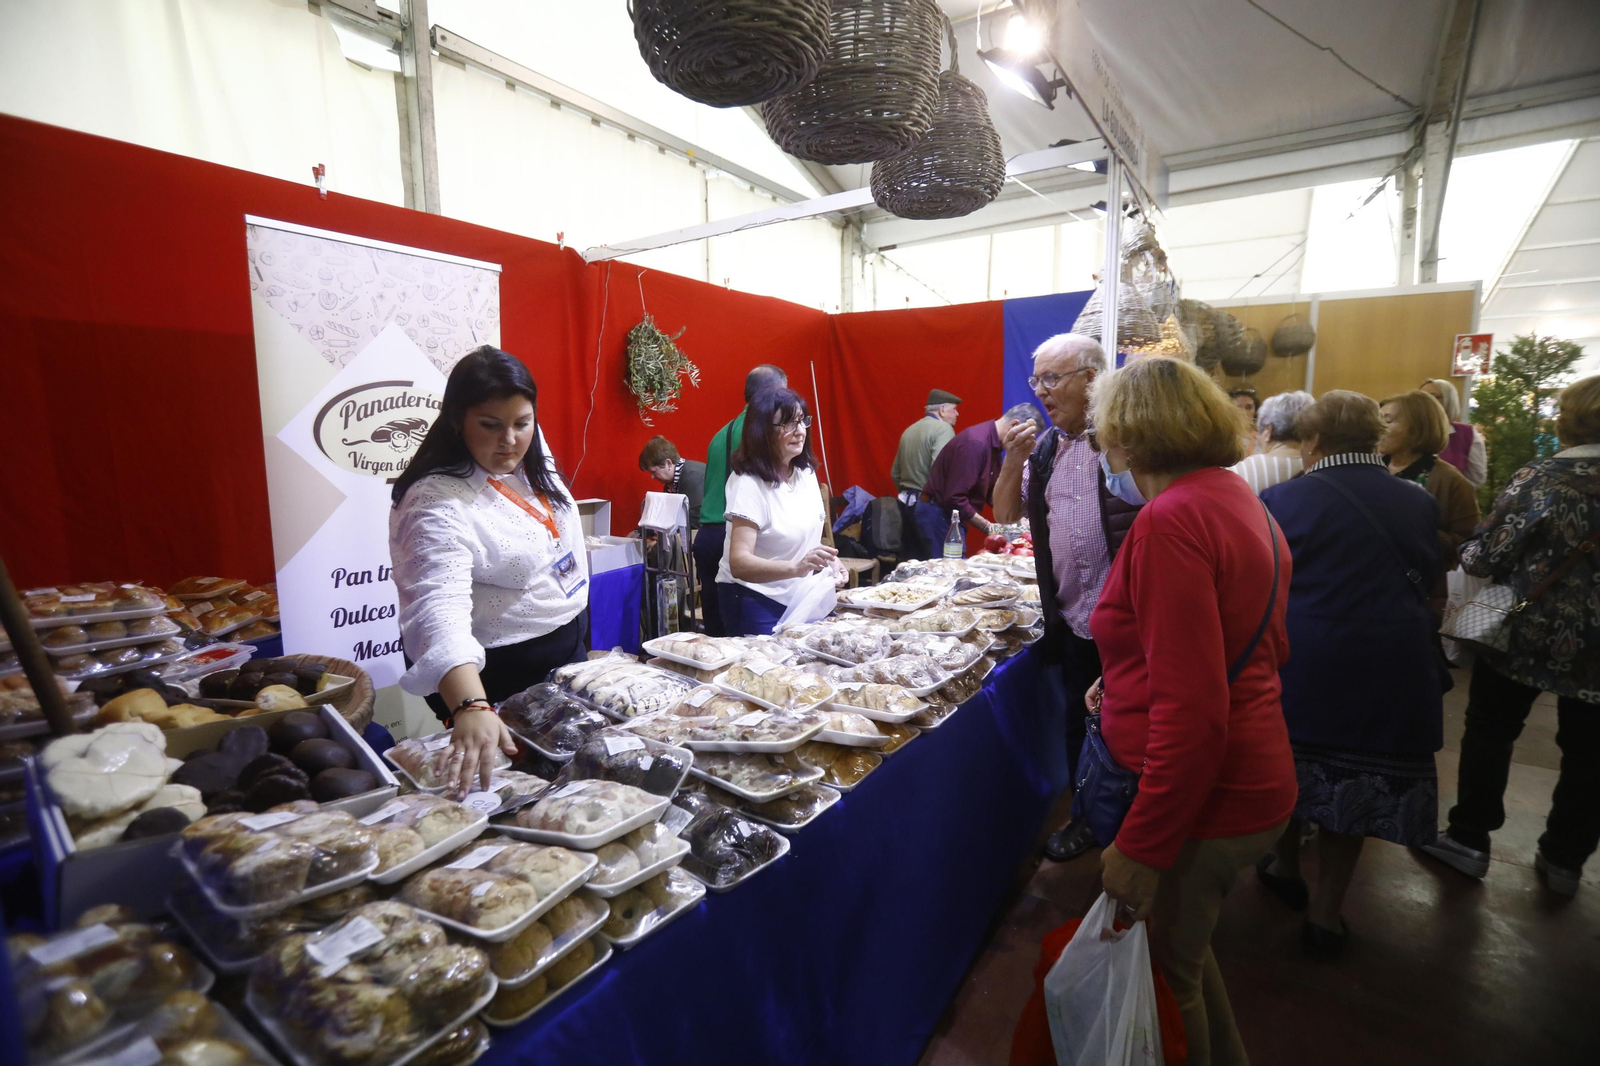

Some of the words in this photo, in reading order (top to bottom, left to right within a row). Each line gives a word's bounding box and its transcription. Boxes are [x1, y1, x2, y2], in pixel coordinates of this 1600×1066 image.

[339, 391, 443, 431] Panadería
[330, 567, 373, 589] Pan
[330, 603, 396, 629] Dulces
